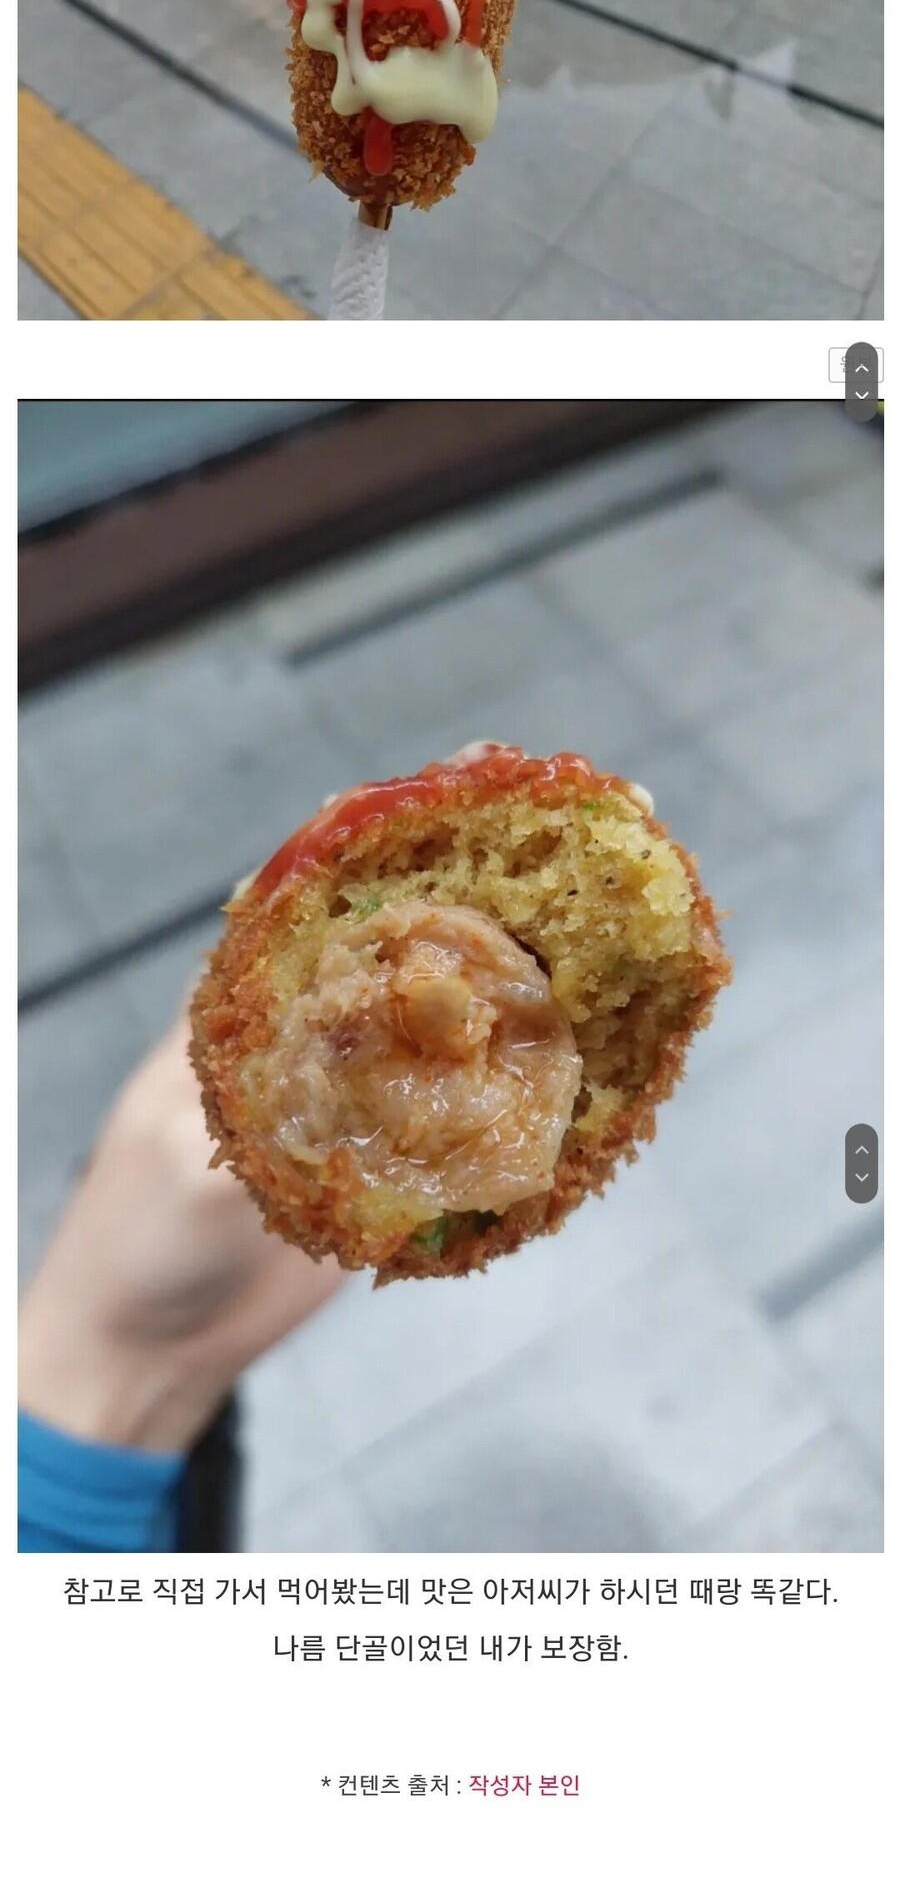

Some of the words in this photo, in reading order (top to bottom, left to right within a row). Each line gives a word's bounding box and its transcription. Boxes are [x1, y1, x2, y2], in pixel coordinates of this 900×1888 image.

[274, 1634, 326, 1663] 나름
[336, 1634, 468, 1662] 단골이었던
[480, 1634, 533, 1663] 내가
[540, 1634, 628, 1663] 보장함.
[338, 1774, 401, 1797] 컨텐츠
[407, 1774, 449, 1797] 출처
[468, 1774, 533, 1797] 작성자
[538, 1774, 580, 1797] 본인
